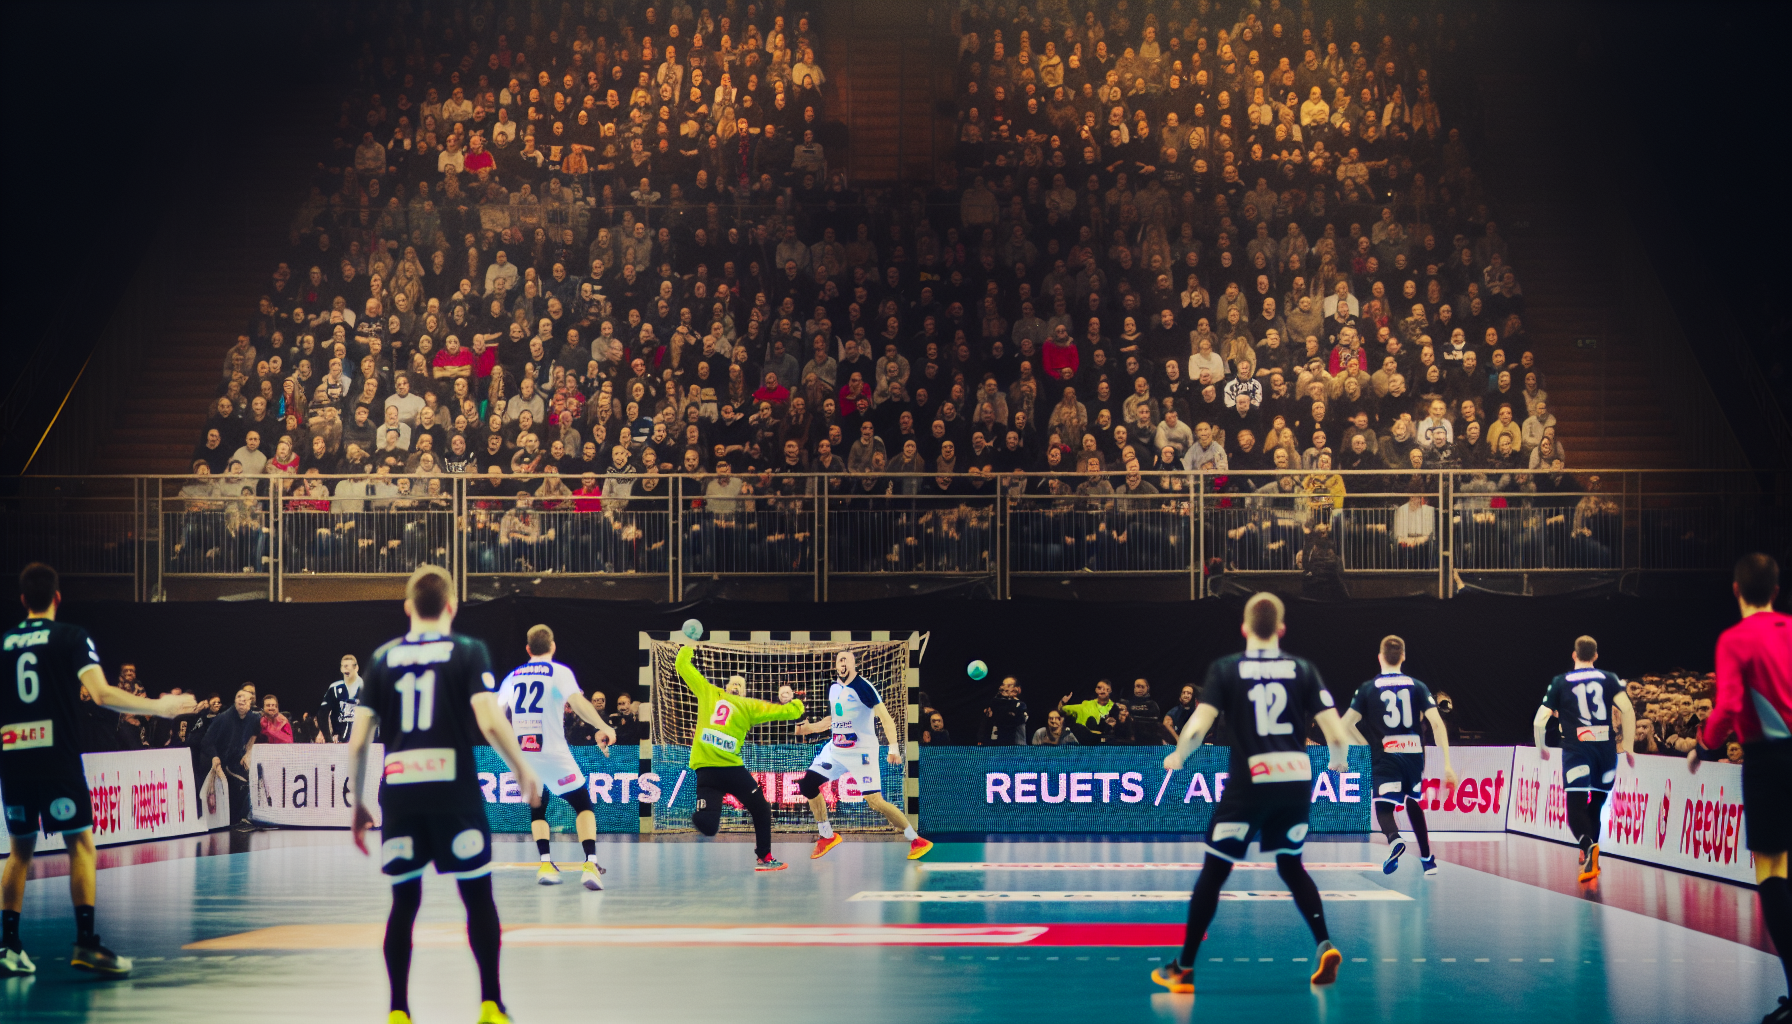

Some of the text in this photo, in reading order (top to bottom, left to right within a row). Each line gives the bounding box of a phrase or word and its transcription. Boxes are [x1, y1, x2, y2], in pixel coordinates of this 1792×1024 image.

[16, 651, 39, 703] 6
[395, 670, 436, 733] 11
[514, 681, 544, 714] 22
[714, 704, 730, 726] 2
[1247, 682, 1294, 736] 12
[1380, 688, 1413, 728] 31
[1571, 681, 1607, 720] 13
[986, 772, 1144, 803] REUETS
